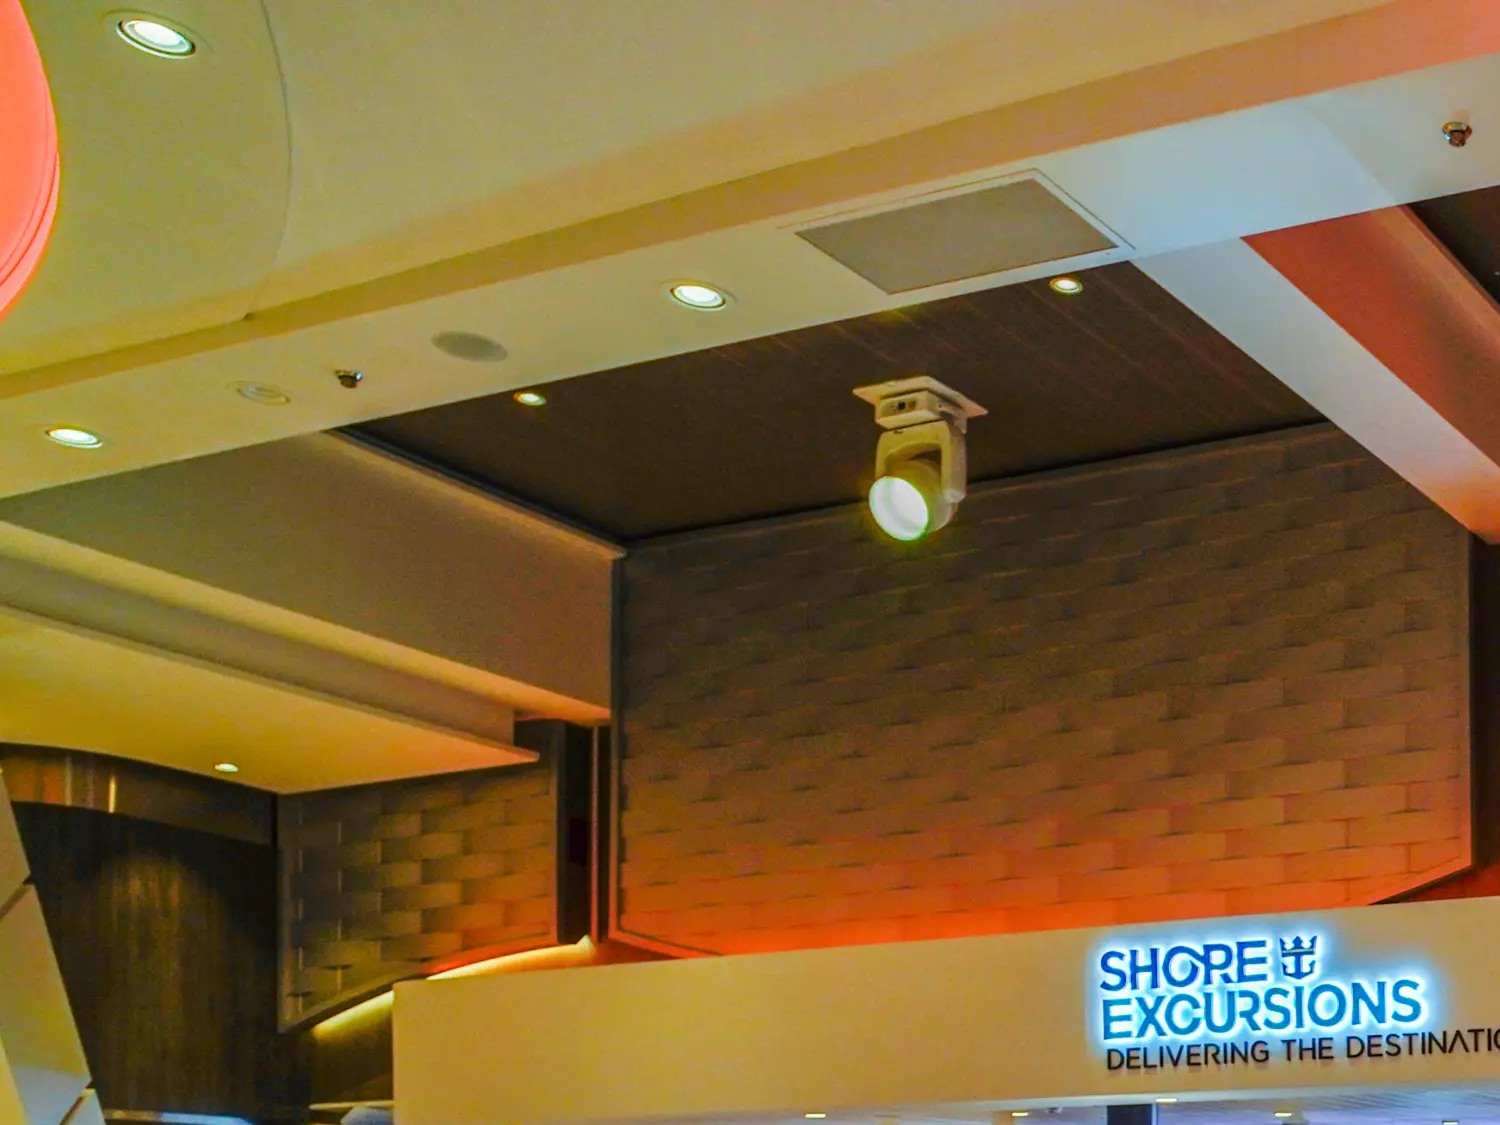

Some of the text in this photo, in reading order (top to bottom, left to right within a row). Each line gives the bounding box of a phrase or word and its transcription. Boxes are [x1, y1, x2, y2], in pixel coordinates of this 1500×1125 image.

[1100, 940, 1267, 991] SHORE
[1103, 979, 1422, 1040] EXCURSIONS
[1107, 1042, 1270, 1070] DELIVERING
[1281, 1038, 1335, 1062] THE
